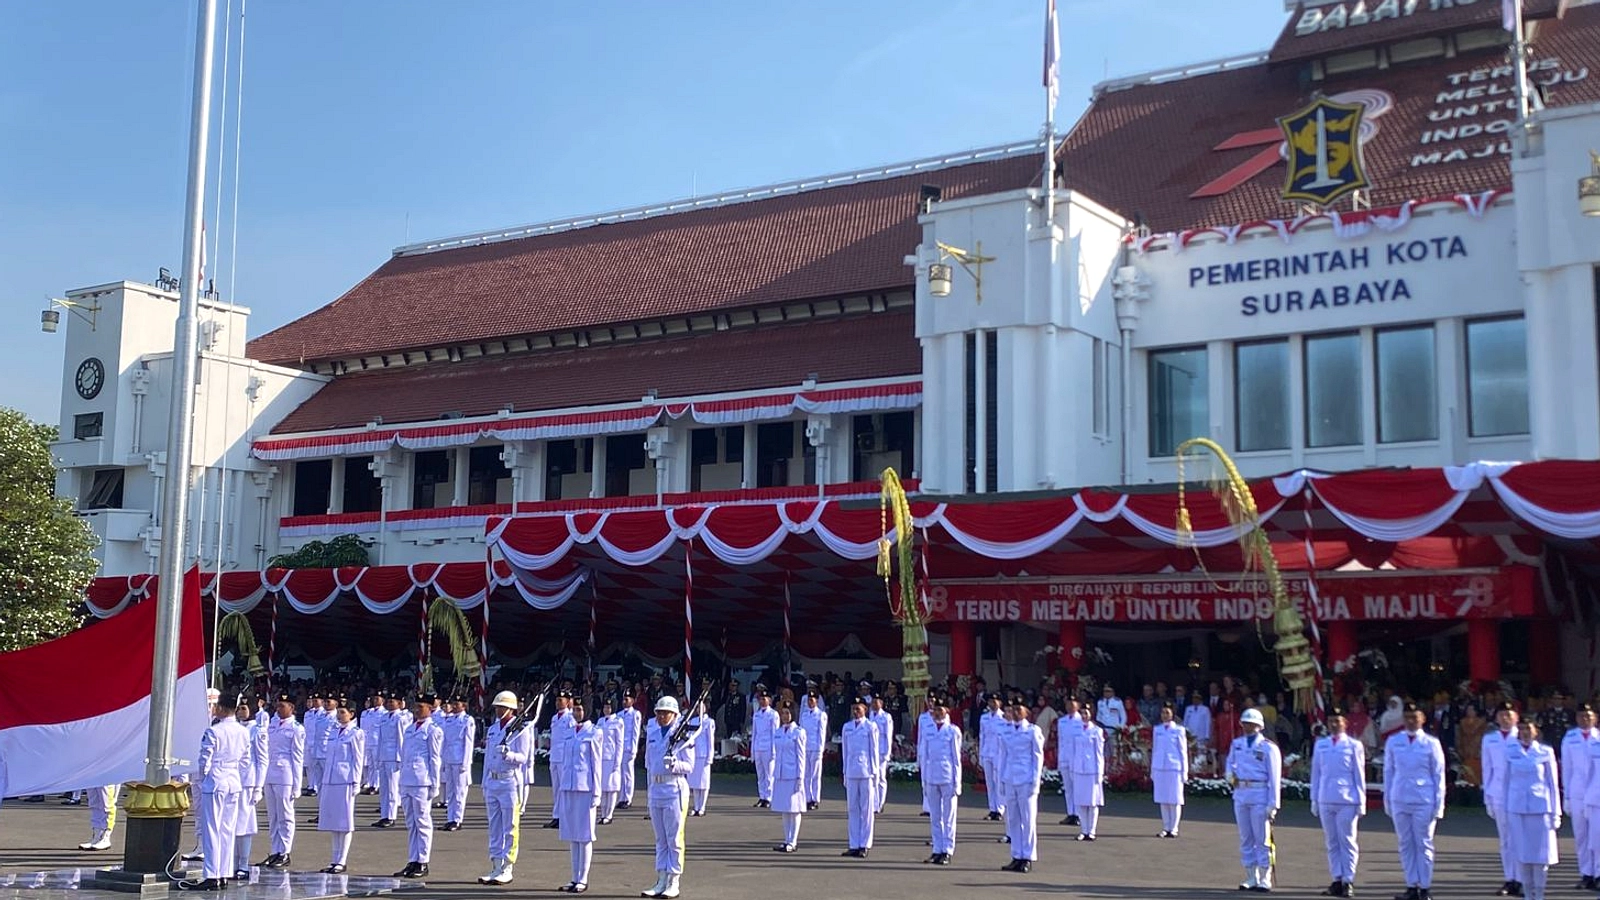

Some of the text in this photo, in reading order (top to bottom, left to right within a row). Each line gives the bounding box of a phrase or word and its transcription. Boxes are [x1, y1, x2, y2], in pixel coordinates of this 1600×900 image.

[1436, 67, 1590, 104] MELJU
[1189, 236, 1468, 288] PEMERINTAH KOTA
[1241, 279, 1411, 316] SURABAYA
[1049, 580, 1307, 596] DIRGAHAYU REPUBLIK INDOESI
[955, 600, 1020, 620] TERUS
[1126, 598, 1202, 620] UNTUK
[1214, 597, 1350, 620] INDOEIA
[1364, 595, 1436, 618] MAJU
